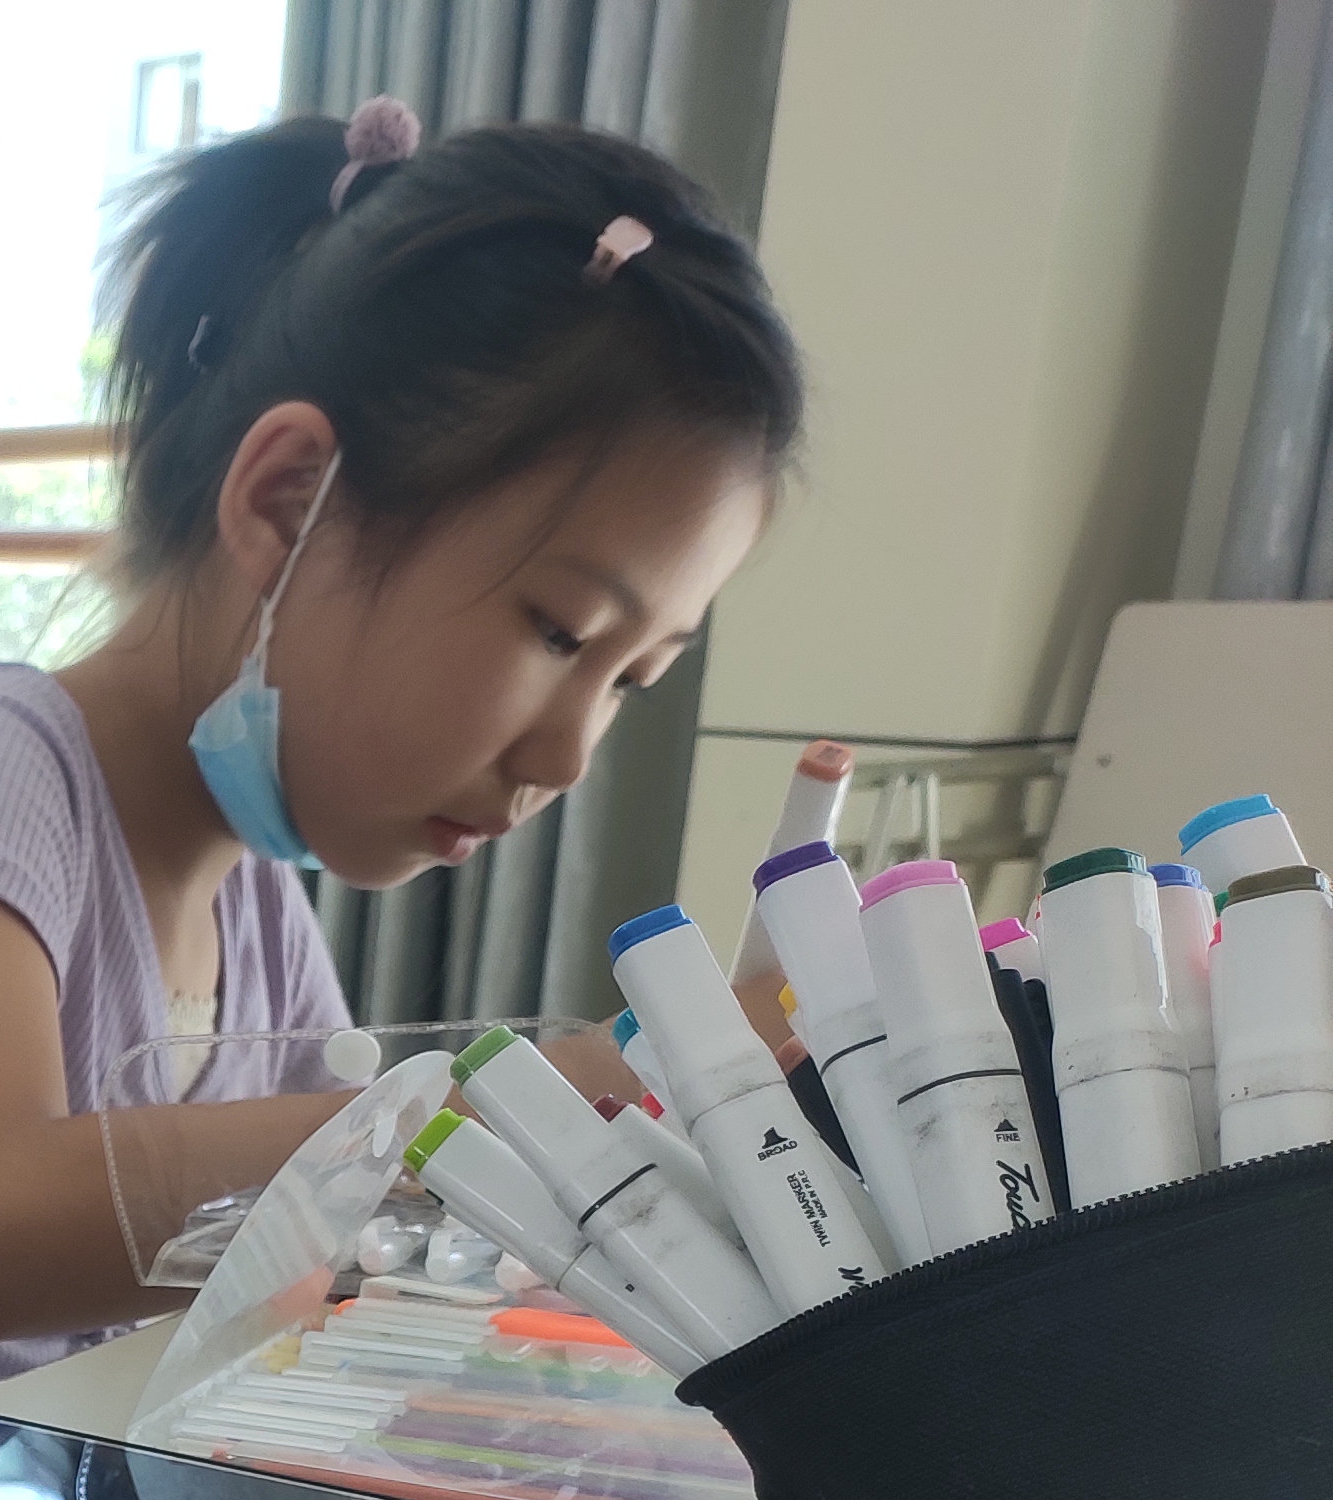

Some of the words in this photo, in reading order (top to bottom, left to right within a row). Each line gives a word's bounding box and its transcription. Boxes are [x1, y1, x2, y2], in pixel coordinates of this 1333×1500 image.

[995, 1132, 1021, 1142] FINE
[757, 1139, 798, 1161] BROAD
[786, 1172, 817, 1220] MARKER
[809, 1219, 831, 1248] TWIN
